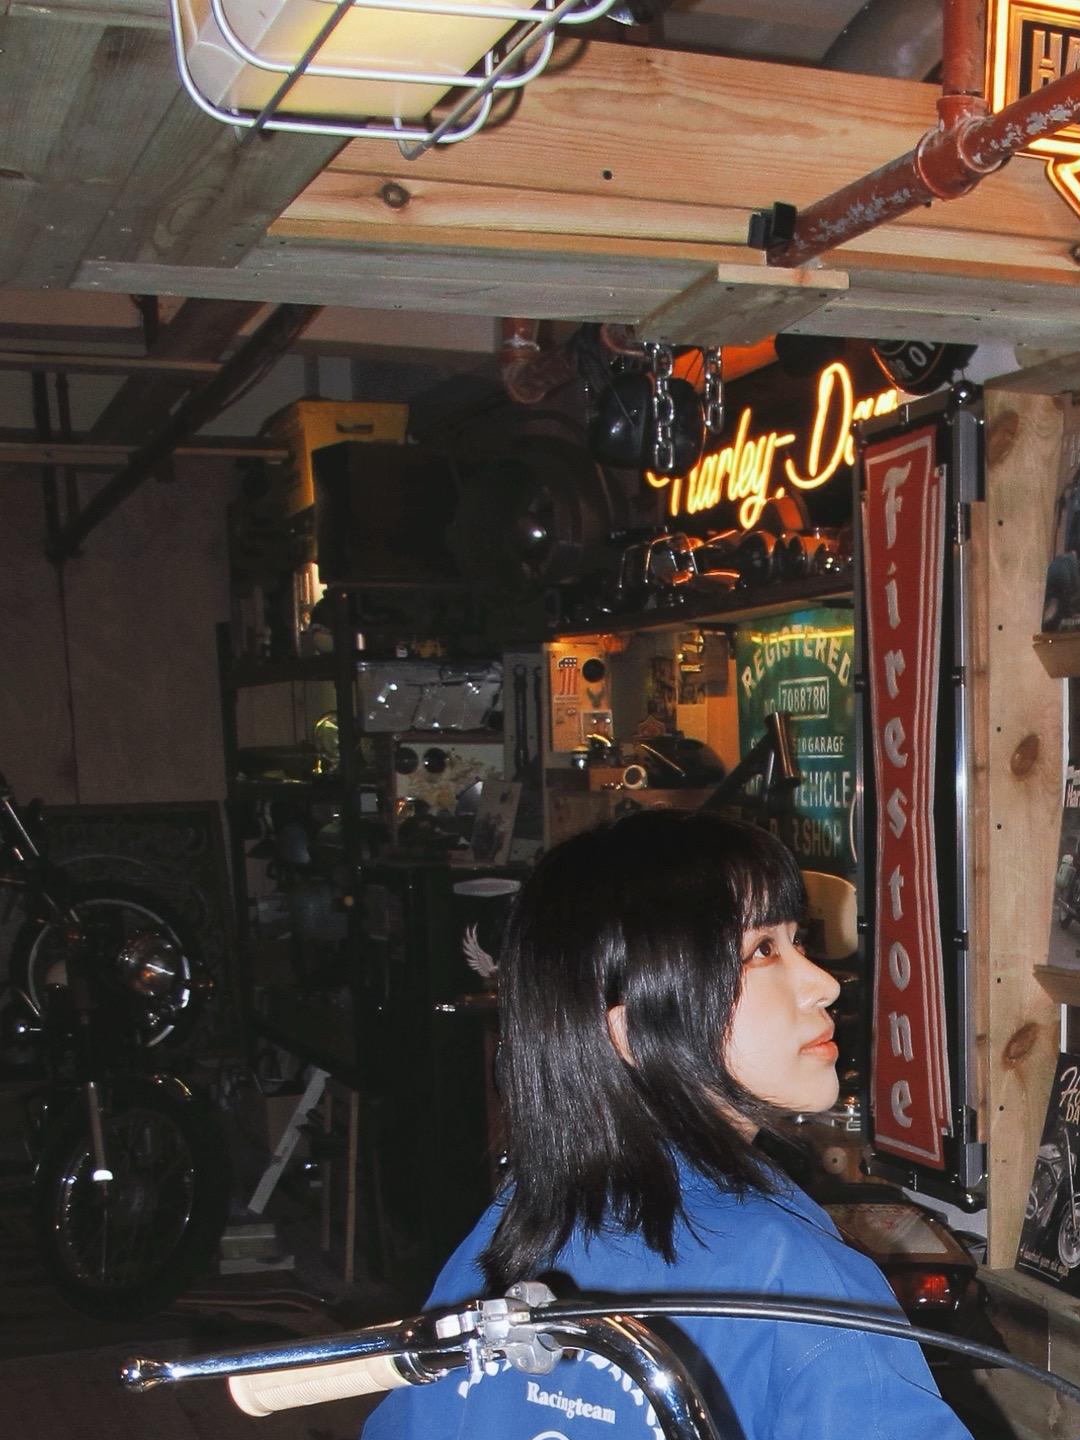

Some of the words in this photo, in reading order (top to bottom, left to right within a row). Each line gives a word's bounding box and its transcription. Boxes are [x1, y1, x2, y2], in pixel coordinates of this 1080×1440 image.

[741, 624, 851, 699] REGISTERED
[781, 685, 827, 713] 7088780
[883, 460, 914, 1129] Firestone
[527, 1381, 616, 1425] Racingteam
